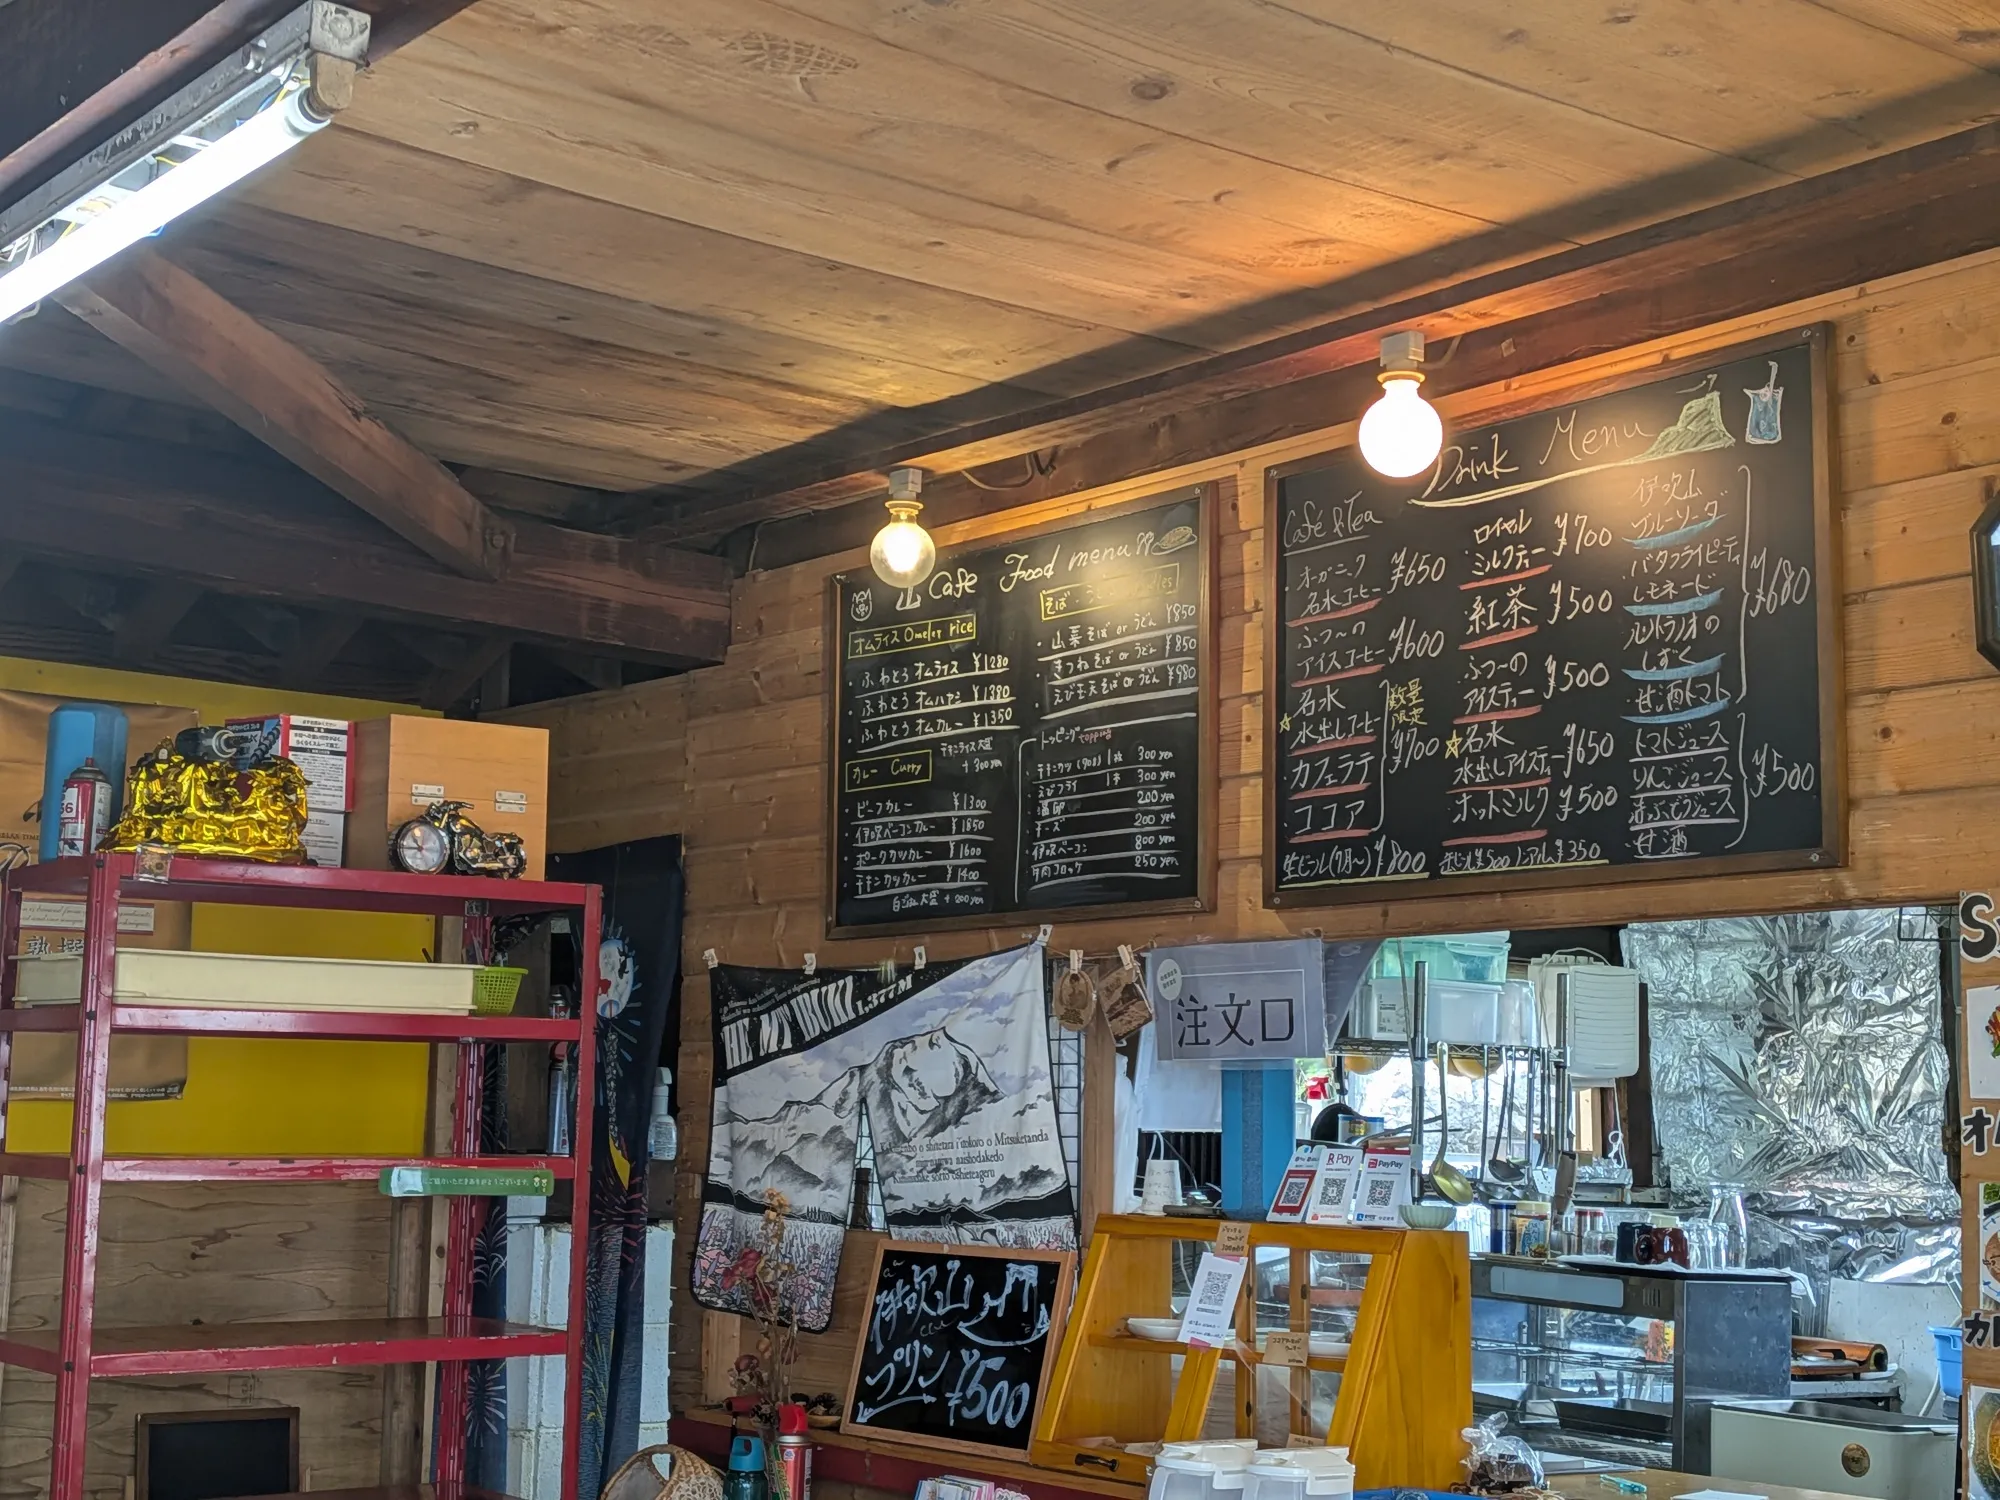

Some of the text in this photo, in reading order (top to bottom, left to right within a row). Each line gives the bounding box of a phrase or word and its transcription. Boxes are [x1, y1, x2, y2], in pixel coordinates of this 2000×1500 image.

[1421, 409, 1655, 498] Drink Menu
[1630, 469, 1702, 507] 伊吹山
[1283, 500, 1327, 548] Café
[1552, 512, 1613, 557] ¥700
[999, 544, 1061, 593] Food
[1068, 544, 1132, 572] menu
[1387, 547, 1446, 594] ¥650
[1633, 547, 1811, 617] レモネード ¥680
[1116, 625, 1128, 635] or
[1166, 603, 1196, 623] ¥850
[1465, 580, 1613, 635] 紅茶 ¥500
[854, 630, 900, 655] オムライス
[949, 620, 975, 637] rice
[1119, 652, 1130, 661] or
[1165, 633, 1197, 658] ¥850
[1388, 616, 1445, 664] ¥600
[972, 652, 1009, 672] ¥1280
[1296, 646, 1385, 679] アイスコーヒー
[1642, 646, 1697, 672] しずく
[972, 684, 1011, 702] ¥1380
[1123, 677, 1135, 689] or
[1167, 664, 1197, 687] ¥980
[1543, 654, 1610, 700] ¥500
[1293, 678, 1425, 718] 名水 数量
[1463, 681, 1535, 714] アイスティー
[973, 707, 1013, 728] ¥1350
[1391, 707, 1428, 731] 限定
[1078, 728, 1113, 745] topping
[1137, 745, 1156, 761] 300
[1158, 749, 1173, 761] yen
[1388, 728, 1440, 774] ¥700
[1460, 720, 1515, 753] 名水
[1563, 723, 1614, 779] ¥650
[1635, 721, 1730, 757] トマトジュース
[852, 768, 879, 784] カレー
[891, 759, 922, 776] Curry
[1137, 768, 1156, 783] 300
[1159, 770, 1176, 782] yen
[1290, 752, 1375, 790] カフェラテ
[1750, 743, 1815, 798] ¥500
[952, 792, 987, 811] ¥1300
[1136, 790, 1158, 804] 200
[1159, 792, 1175, 803] yen
[1452, 783, 1619, 828] ホットミルク ¥500
[951, 817, 985, 835] ¥1850
[1133, 813, 1156, 826] 200
[1160, 812, 1176, 825] yen
[1294, 800, 1365, 835] ココア
[949, 840, 982, 860] ¥1600
[1135, 834, 1155, 850] 800
[1158, 834, 1175, 845] yen
[1373, 834, 1427, 878] ¥800
[1554, 839, 1601, 864] ¥350
[946, 864, 980, 882] ¥1400
[1134, 854, 1156, 868] 250
[1159, 856, 1179, 868] yen
[759, 1003, 793, 1057] MT
[790, 975, 857, 1042] IBUKI
[1176, 992, 1294, 1048] 注文口
[1378, 1160, 1404, 1169] PayPay
[864, 1339, 1031, 1429] プリン ¥500
